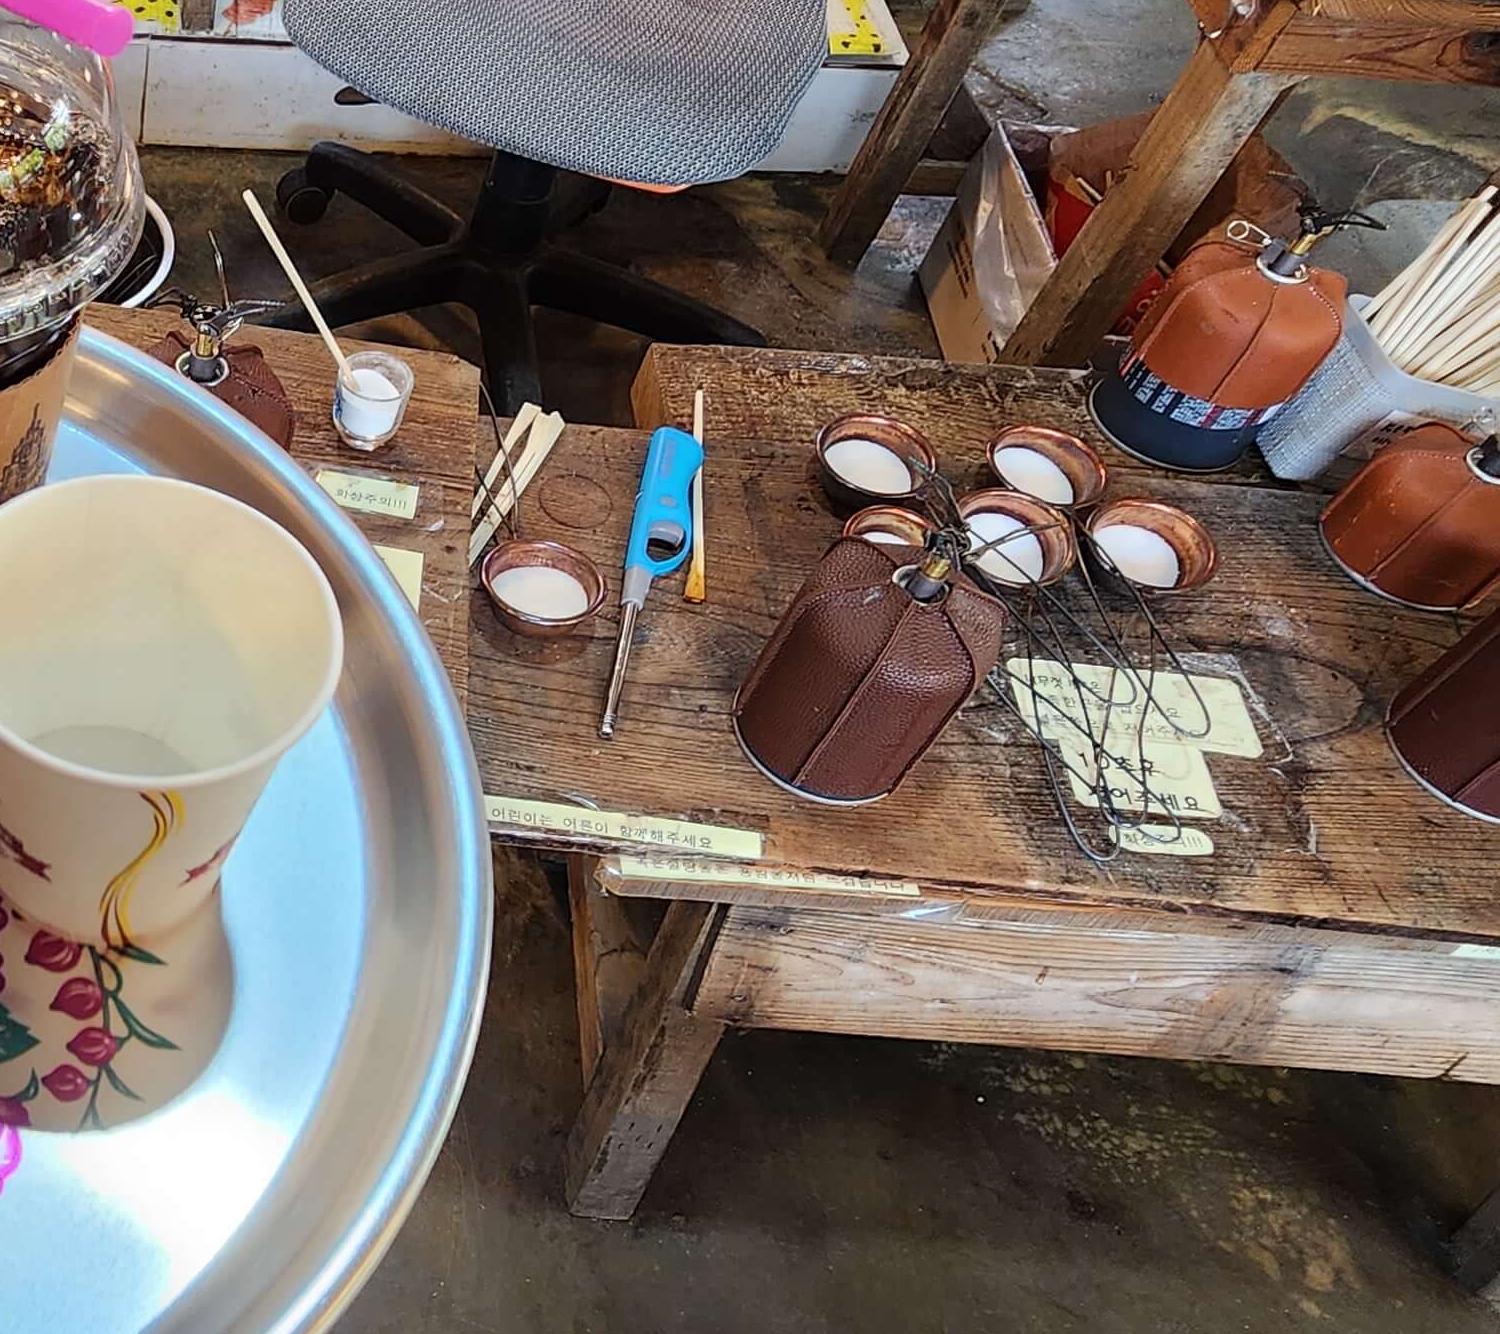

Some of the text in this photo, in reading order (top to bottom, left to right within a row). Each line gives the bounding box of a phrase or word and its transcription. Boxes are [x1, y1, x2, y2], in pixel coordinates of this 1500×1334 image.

[491, 807, 713, 849] 어린이는 어른이 함께해주세요
